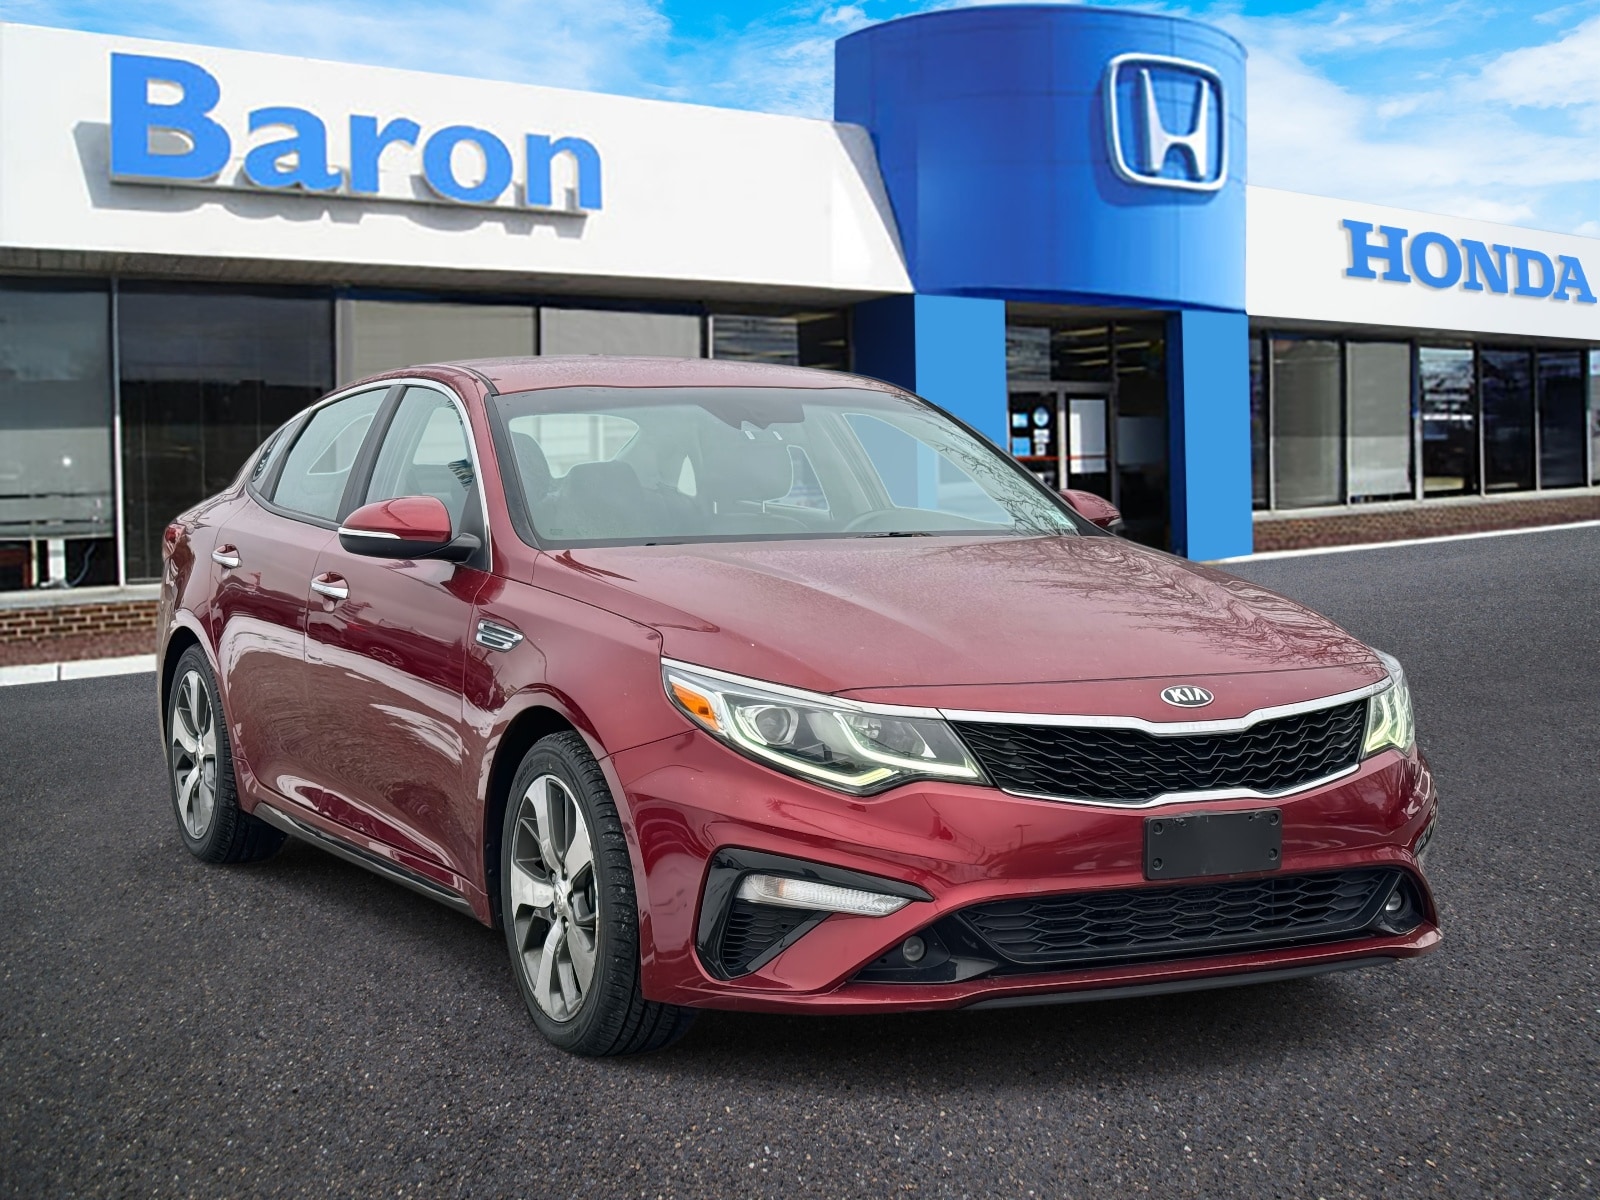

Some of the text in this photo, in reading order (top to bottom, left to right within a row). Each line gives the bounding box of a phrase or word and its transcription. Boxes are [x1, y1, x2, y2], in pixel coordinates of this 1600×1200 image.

[110, 52, 602, 210] Baron
[1343, 219, 1598, 304] HONDA
[1167, 687, 1210, 702] KIA
